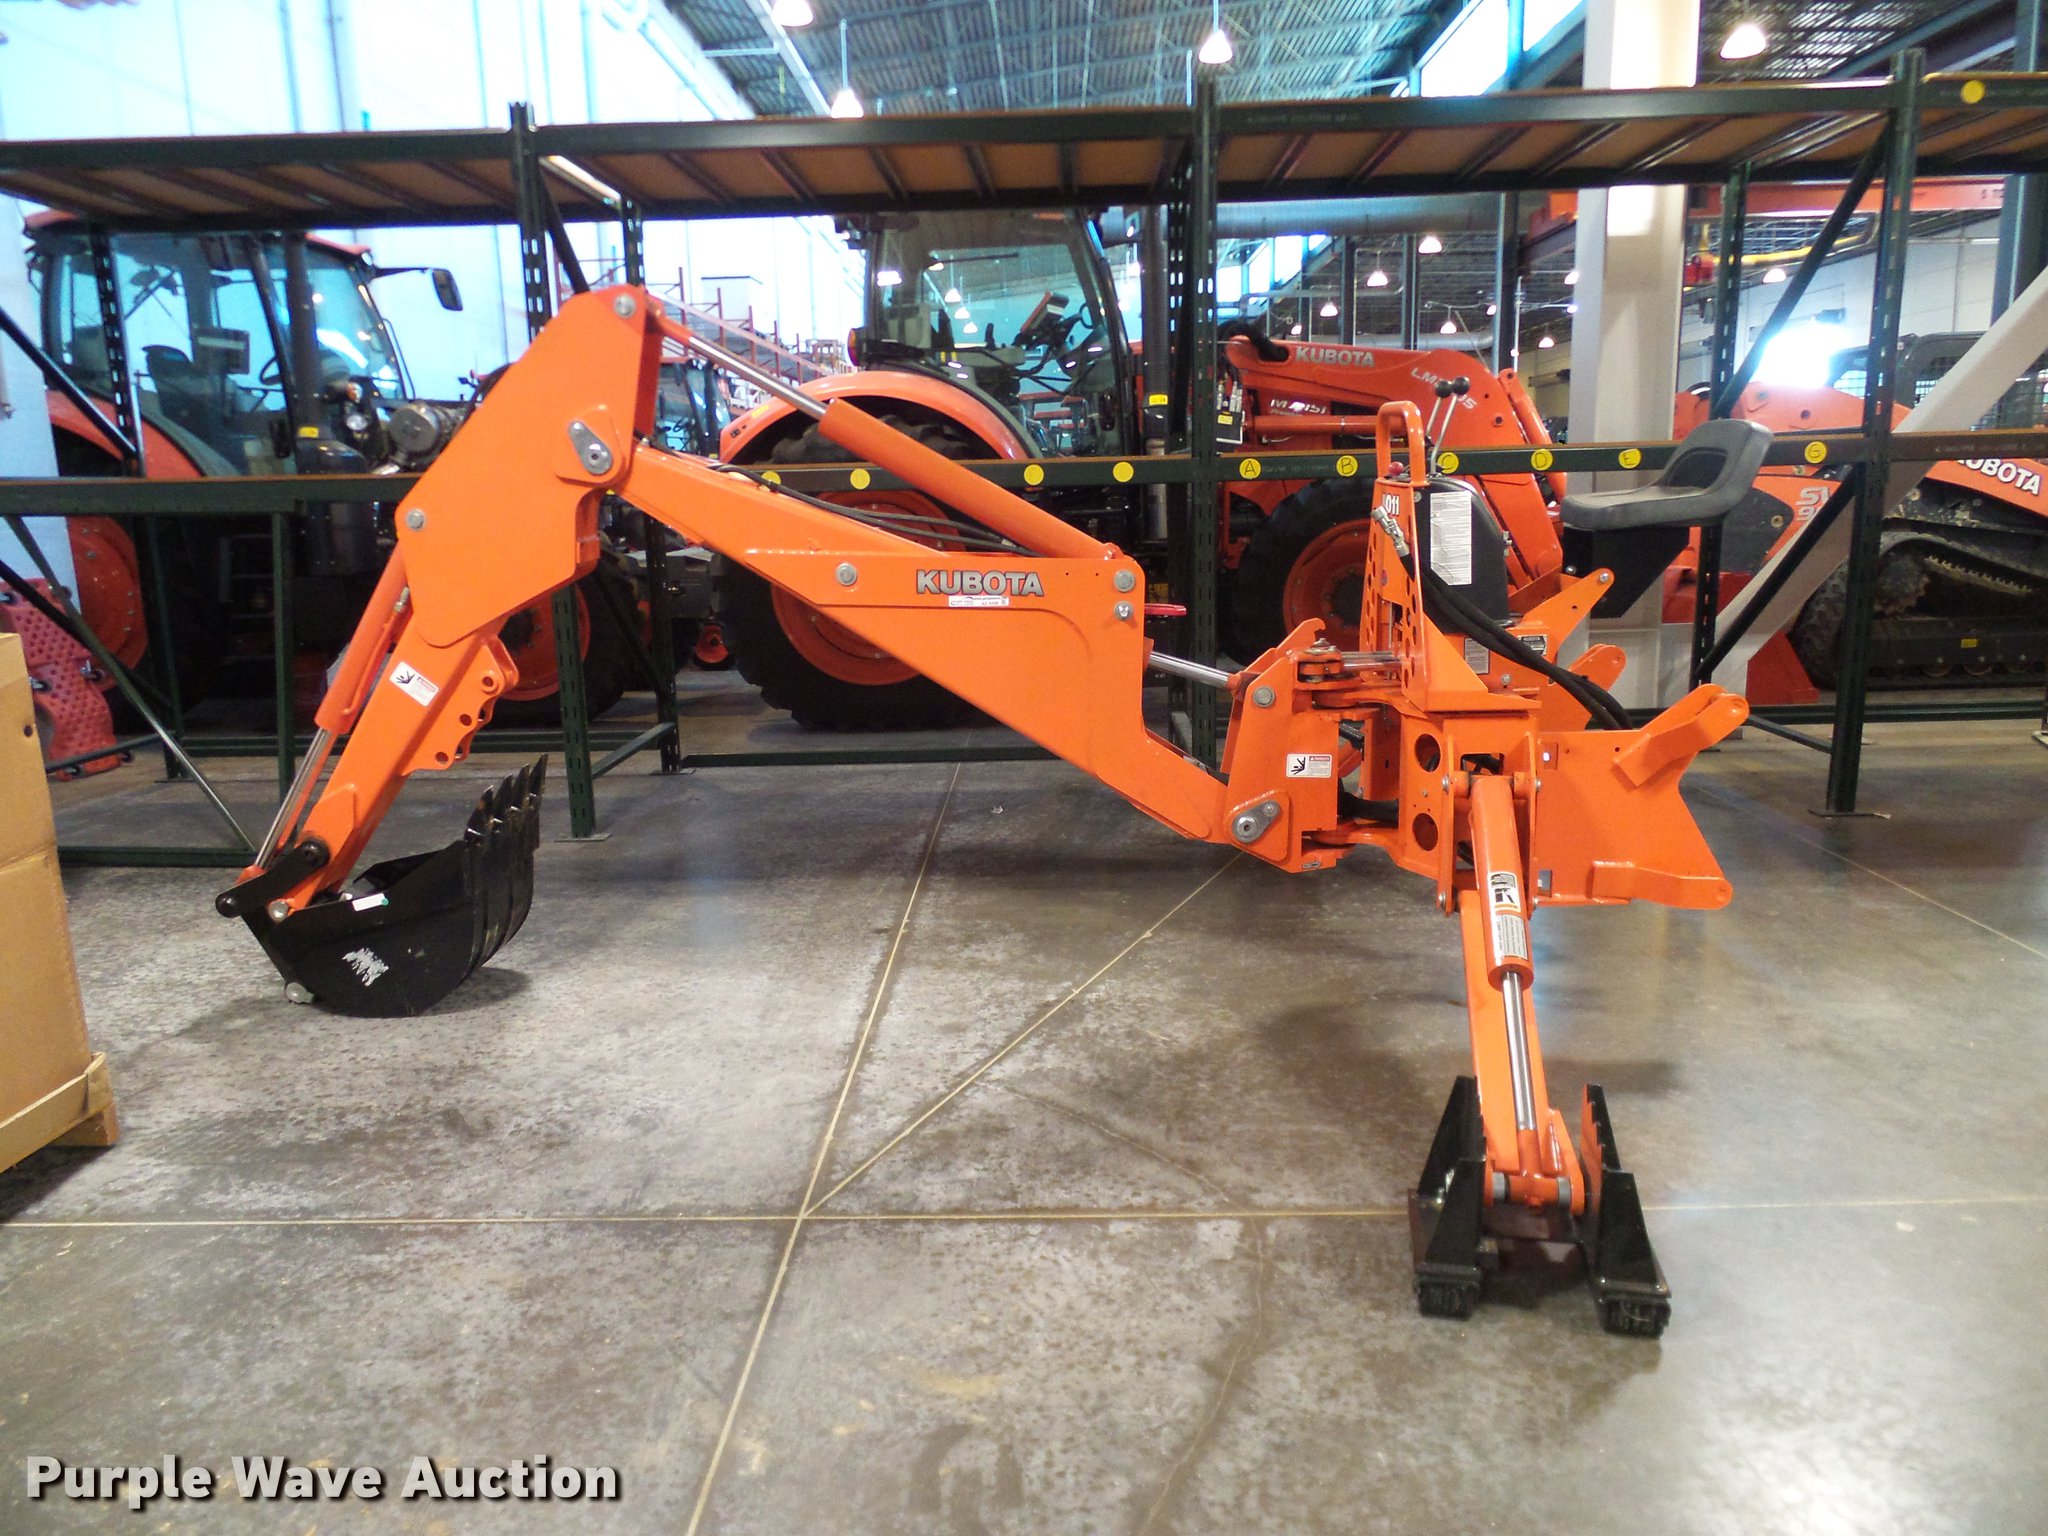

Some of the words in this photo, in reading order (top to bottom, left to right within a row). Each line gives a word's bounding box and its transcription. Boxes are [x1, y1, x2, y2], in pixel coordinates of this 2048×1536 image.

[1295, 346, 1375, 367] KUBOTA
[1957, 458, 2041, 496] UBOTA
[916, 569, 1044, 597] KUBOTA
